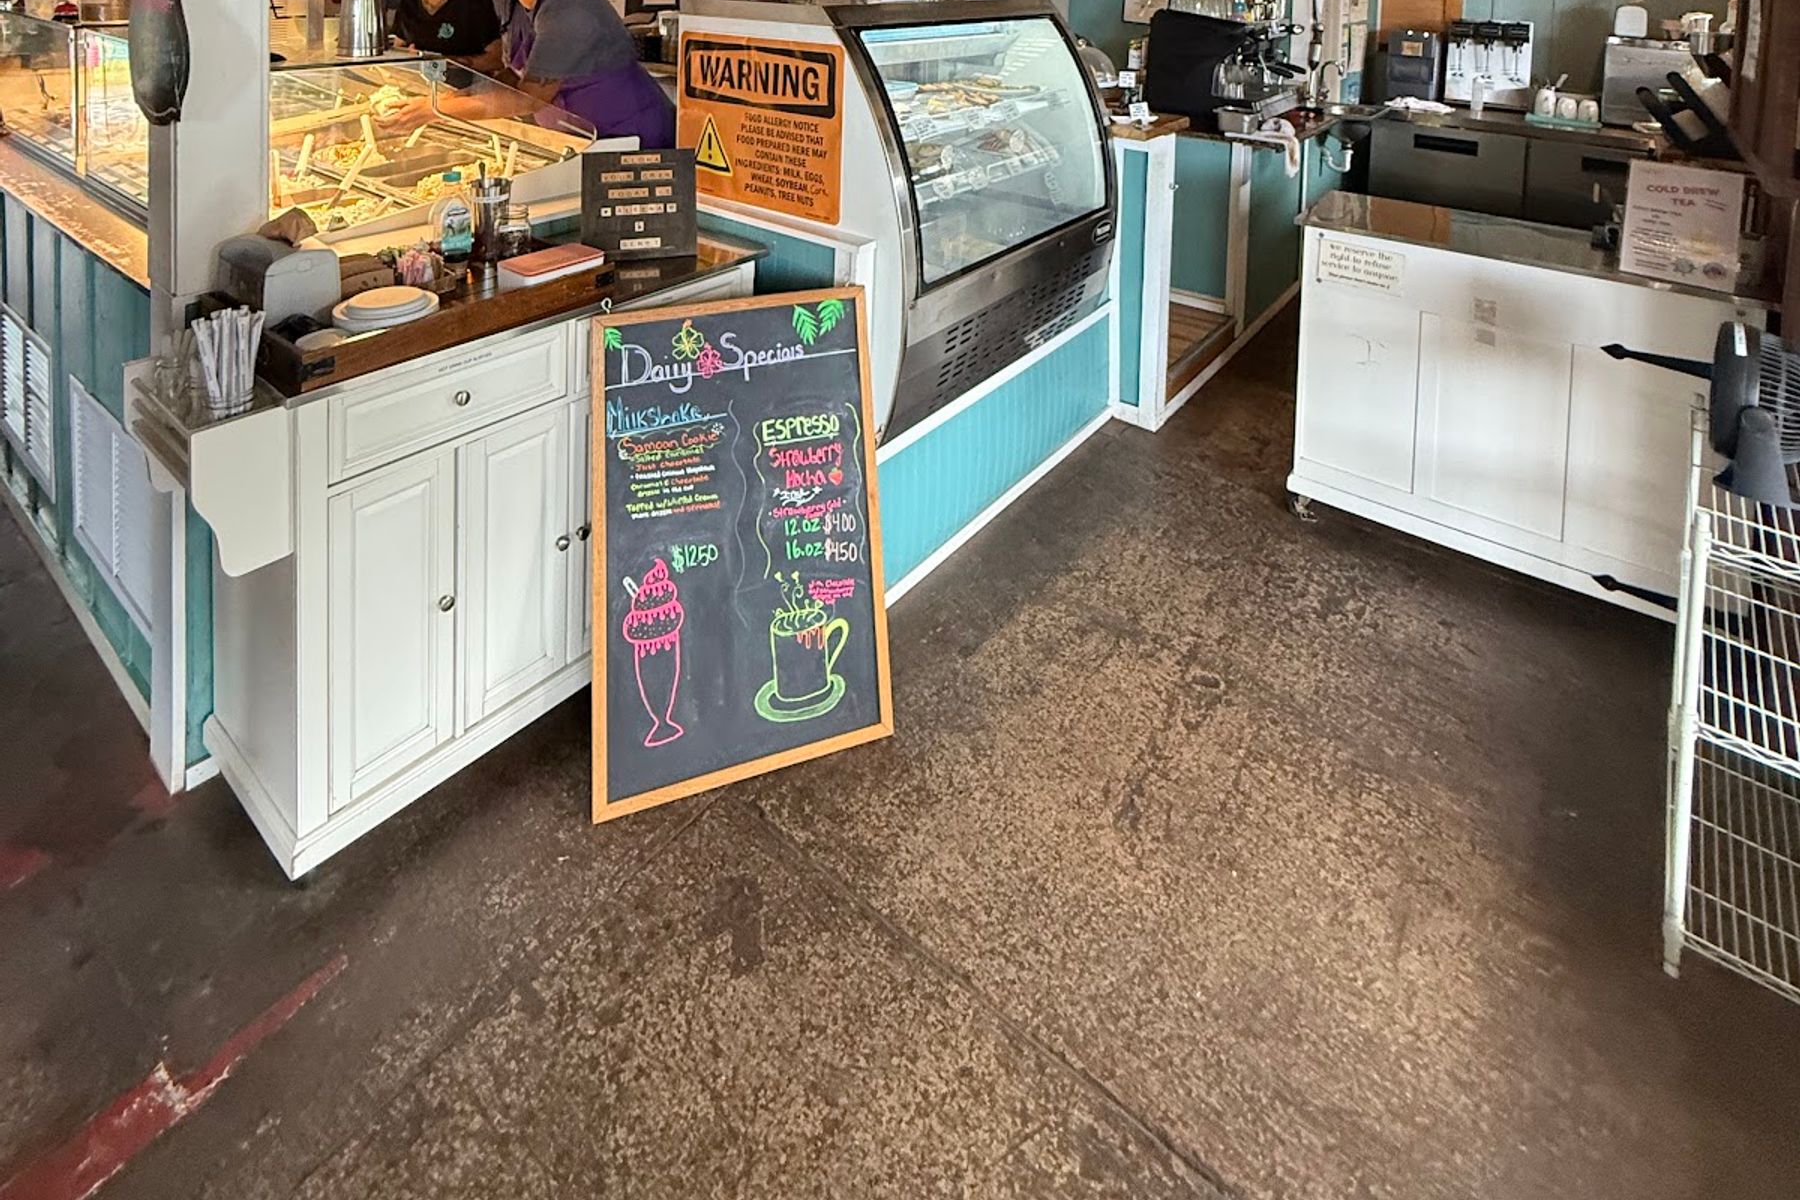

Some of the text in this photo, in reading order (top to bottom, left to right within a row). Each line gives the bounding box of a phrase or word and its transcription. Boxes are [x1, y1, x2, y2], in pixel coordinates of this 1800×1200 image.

[700, 54, 821, 102] WARNING
[744, 111, 820, 134] FOOD ALLERGY NOTICE
[740, 123, 824, 147] PLEASE BE ADVISED THAT
[736, 133, 828, 160] FOOD PREPARED HERE MAY
[735, 157, 782, 177] INGREDIENTS:
[754, 149, 807, 169] CONTAIN THESE
[778, 188, 796, 202] TREE
[797, 194, 815, 208] NUTS
[1646, 184, 1720, 196] COLD BREW
[1671, 198, 1696, 207] TEA
[681, 430, 719, 448] Cookie
